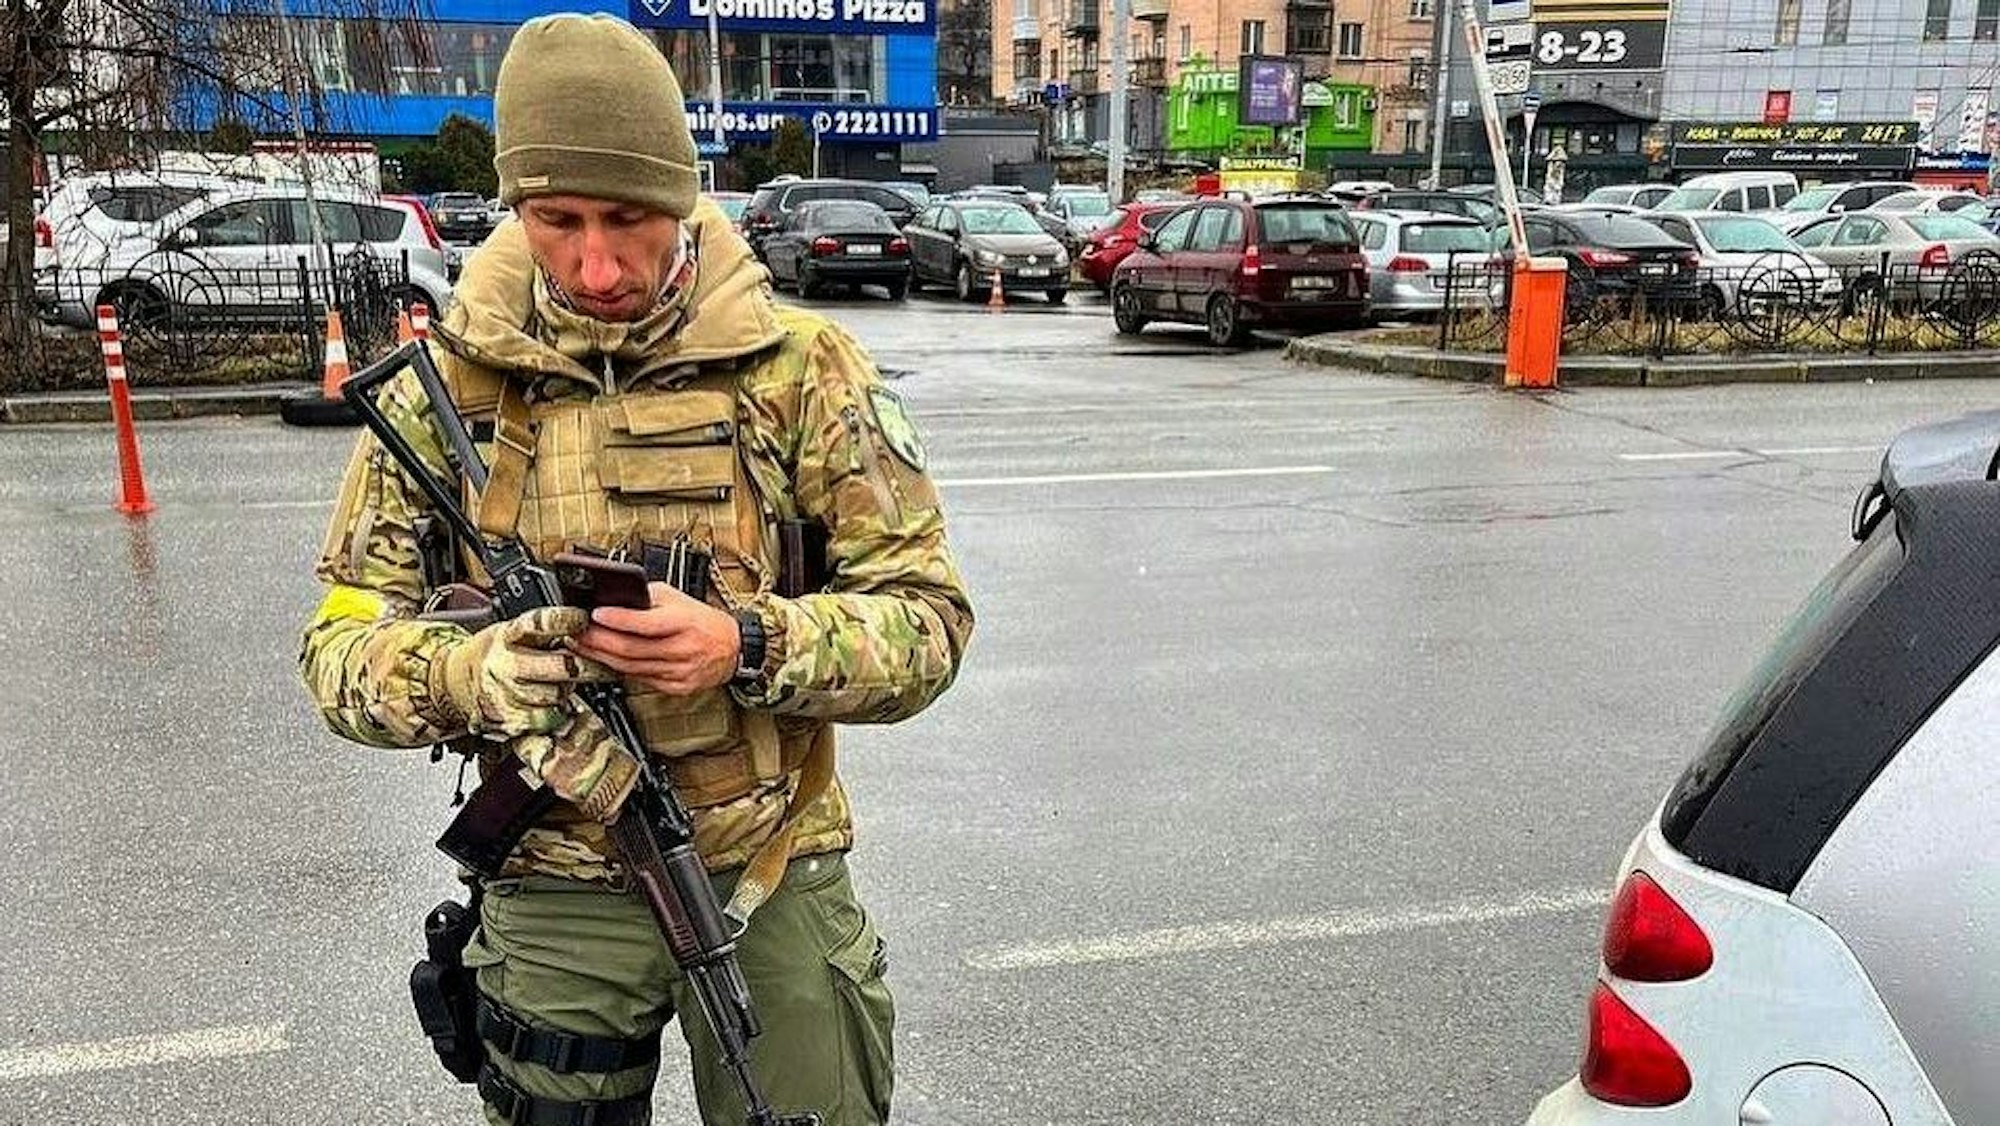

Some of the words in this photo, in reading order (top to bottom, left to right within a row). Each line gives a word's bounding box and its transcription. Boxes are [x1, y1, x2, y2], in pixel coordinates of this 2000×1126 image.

[843, 0, 926, 22] Pizza
[1538, 29, 1628, 64] 8-23
[835, 111, 929, 135] 2221111
[1860, 125, 1908, 141] 24/7
